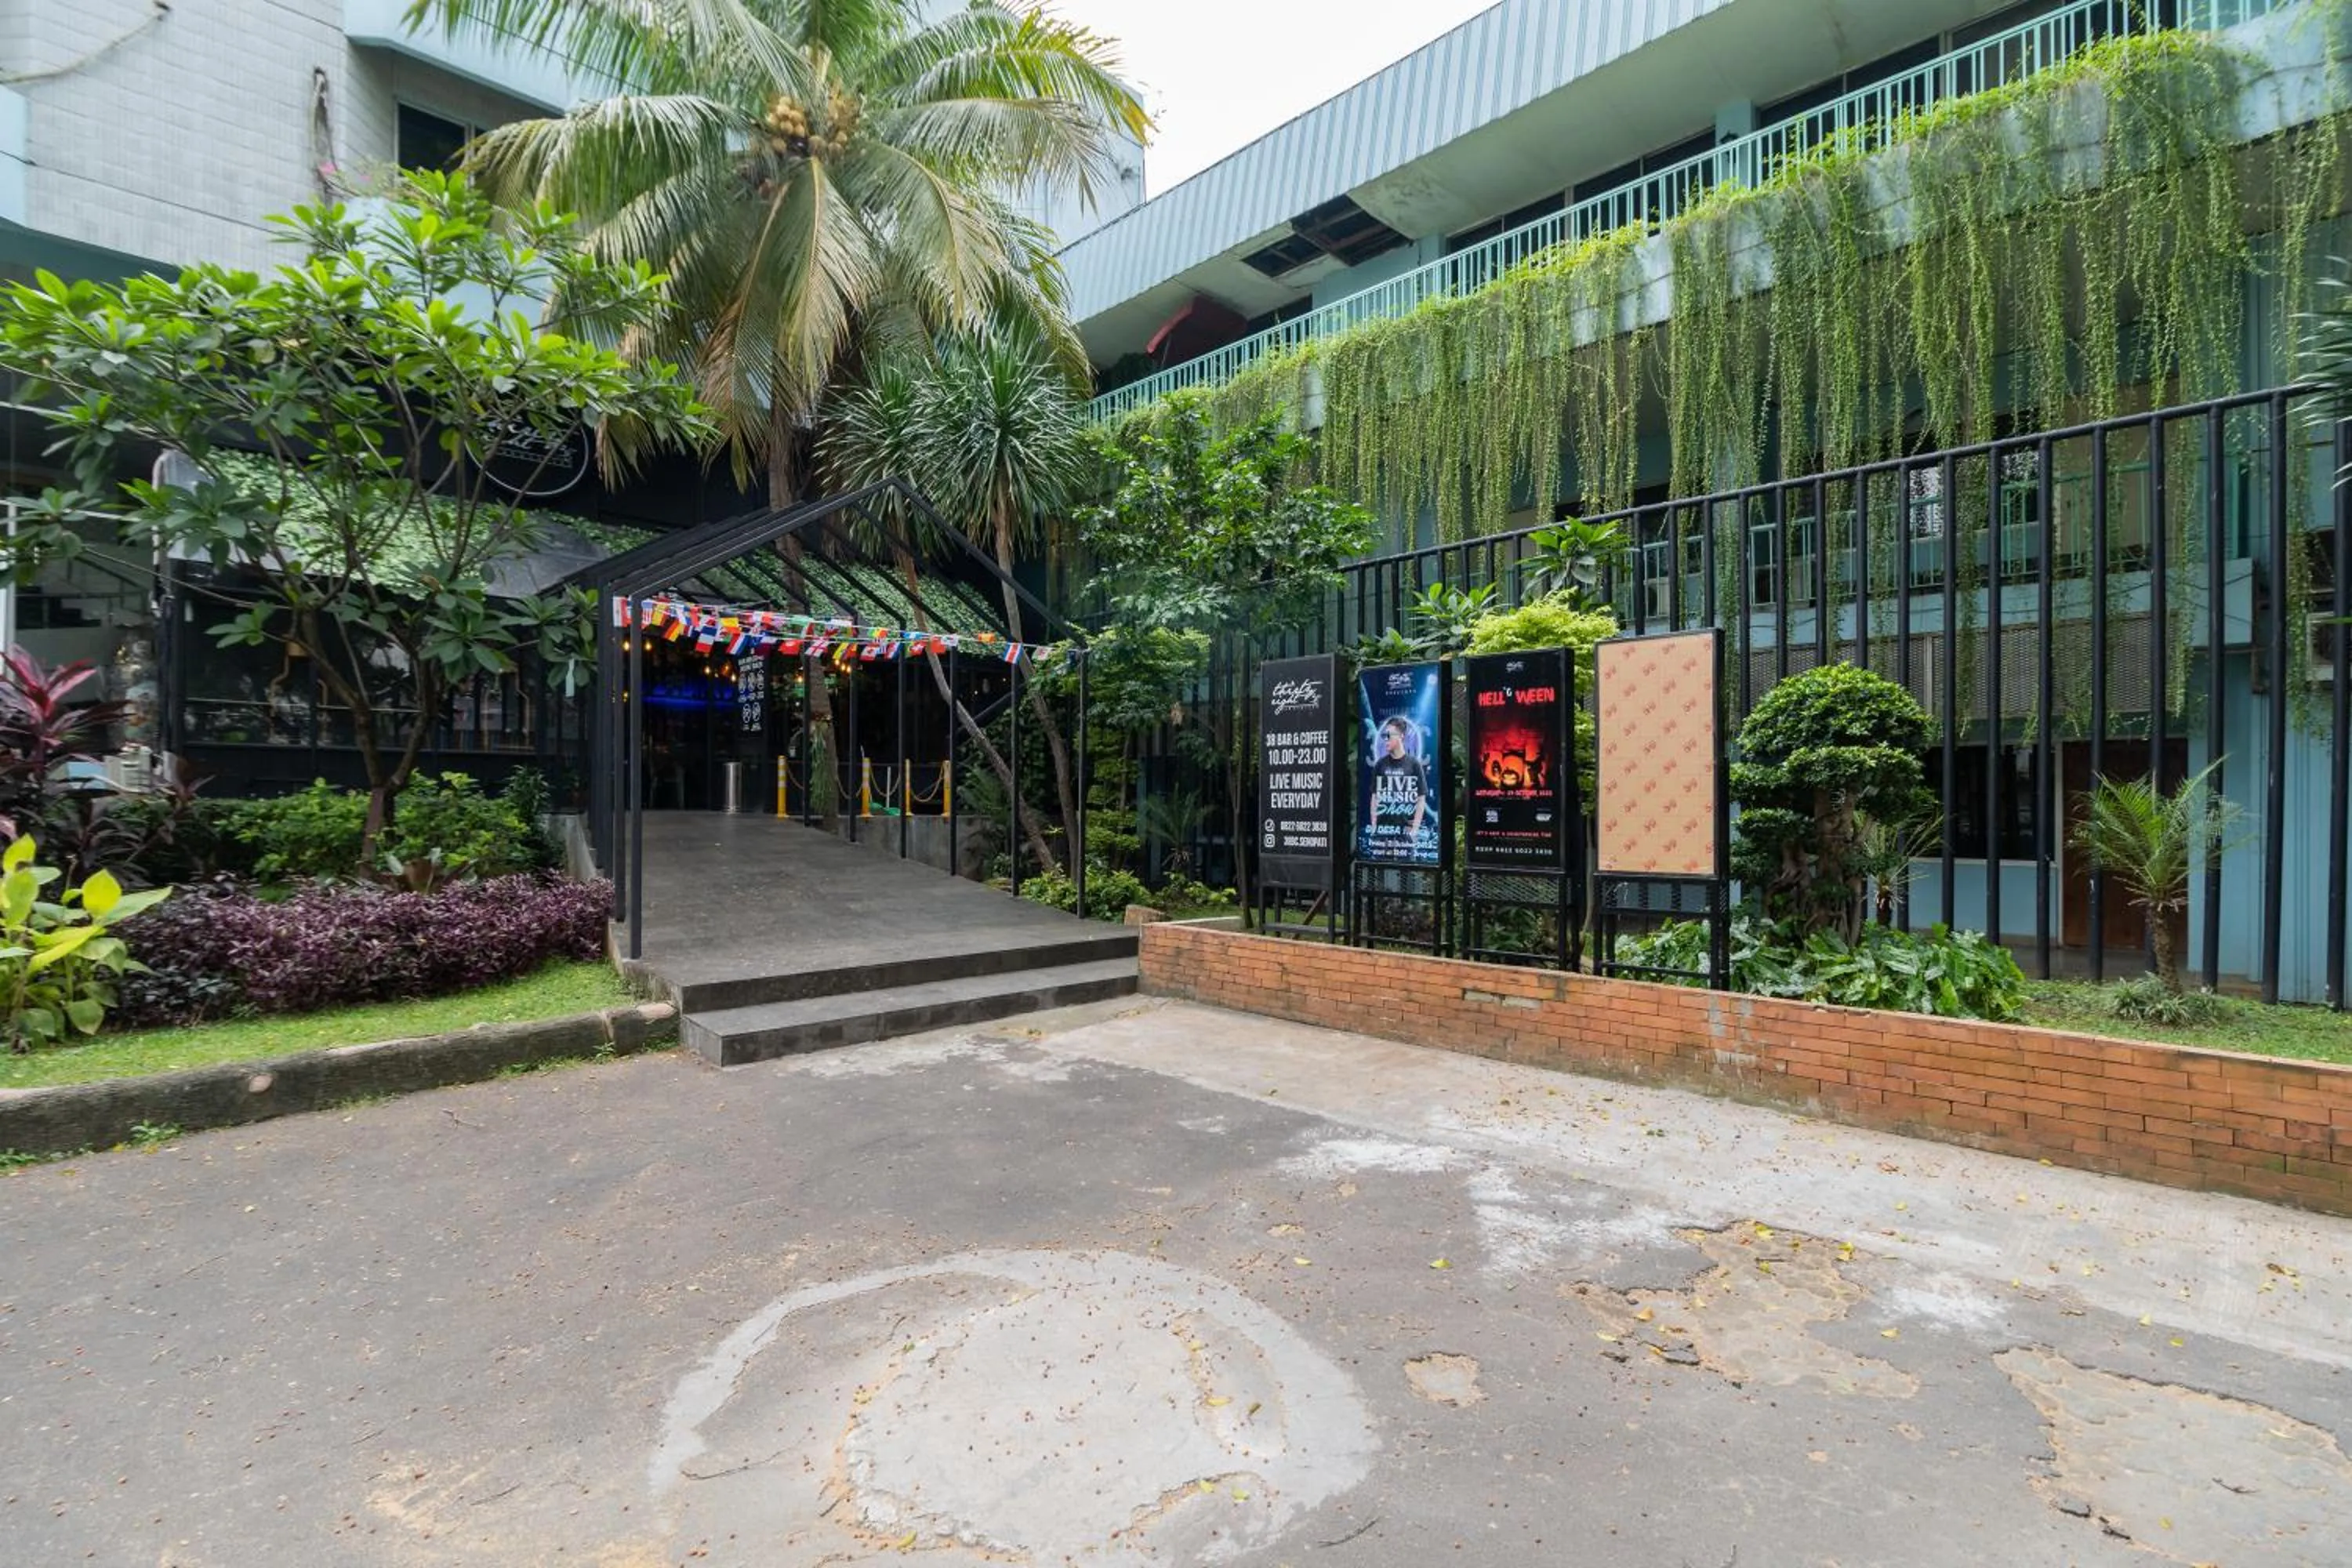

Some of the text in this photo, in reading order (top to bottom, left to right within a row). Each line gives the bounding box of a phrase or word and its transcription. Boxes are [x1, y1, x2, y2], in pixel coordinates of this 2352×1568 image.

[1479, 691, 1505, 706] HELL
[1515, 687, 1555, 706] WEEN
[1266, 730, 1329, 746] 38 BAR & COFFEE
[1269, 747, 1327, 765] 10.00-23.00
[1269, 772, 1323, 789] LIVE MUSIC
[1376, 775, 1418, 792] LIVE
[1271, 792, 1321, 809] EVERYDAY
[1376, 791, 1418, 804] MUSIC
